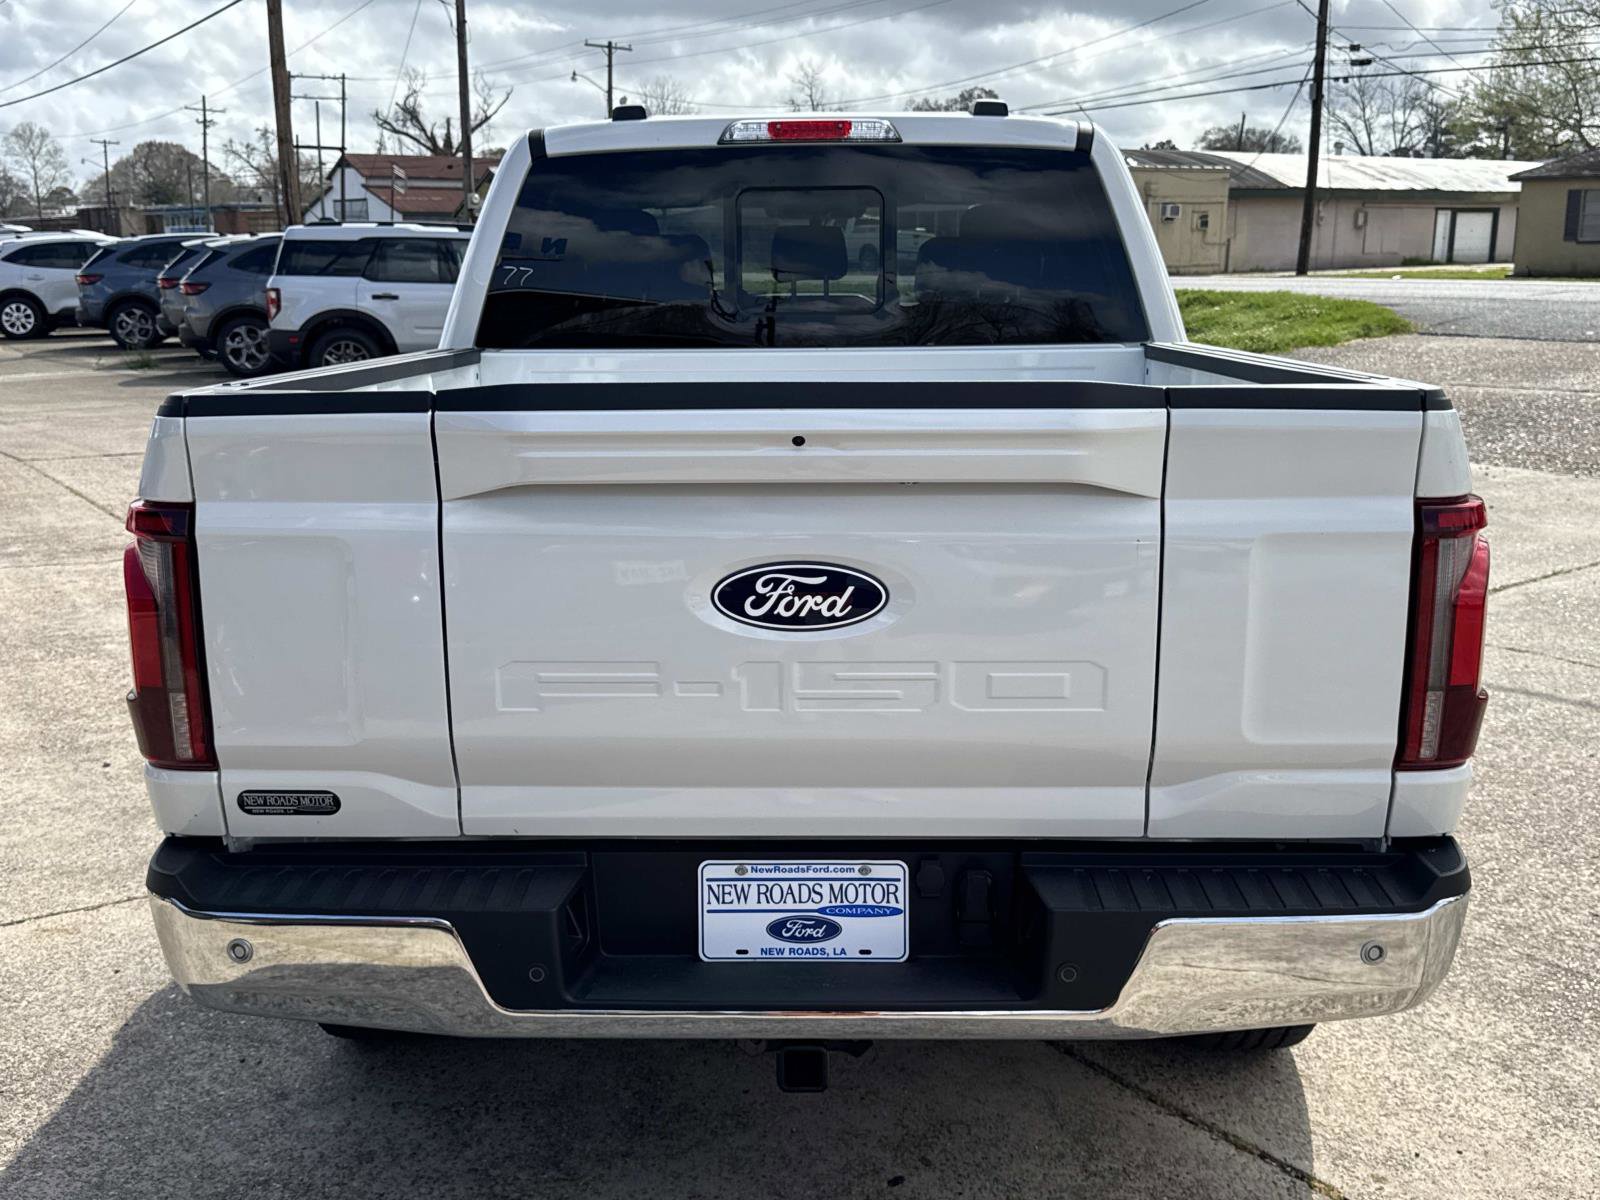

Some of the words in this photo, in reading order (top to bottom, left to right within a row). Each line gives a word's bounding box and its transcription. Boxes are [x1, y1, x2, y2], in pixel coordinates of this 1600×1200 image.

[502, 265, 534, 287] 77
[744, 573, 855, 618] Ford
[495, 660, 1108, 713] F-150
[243, 796, 265, 806] NEW
[266, 796, 299, 806] ROADS
[300, 796, 334, 806] MOTOR
[750, 865, 856, 874] NewRoadsFord.com
[706, 883, 752, 905] NEW
[756, 883, 824, 904] ROADS
[828, 883, 900, 904] MOTOR
[826, 907, 894, 915] COMPANY
[781, 919, 827, 938] Ford
[760, 947, 786, 956] NEW
[788, 947, 830, 958] ROADS,
[832, 947, 848, 956] LA
